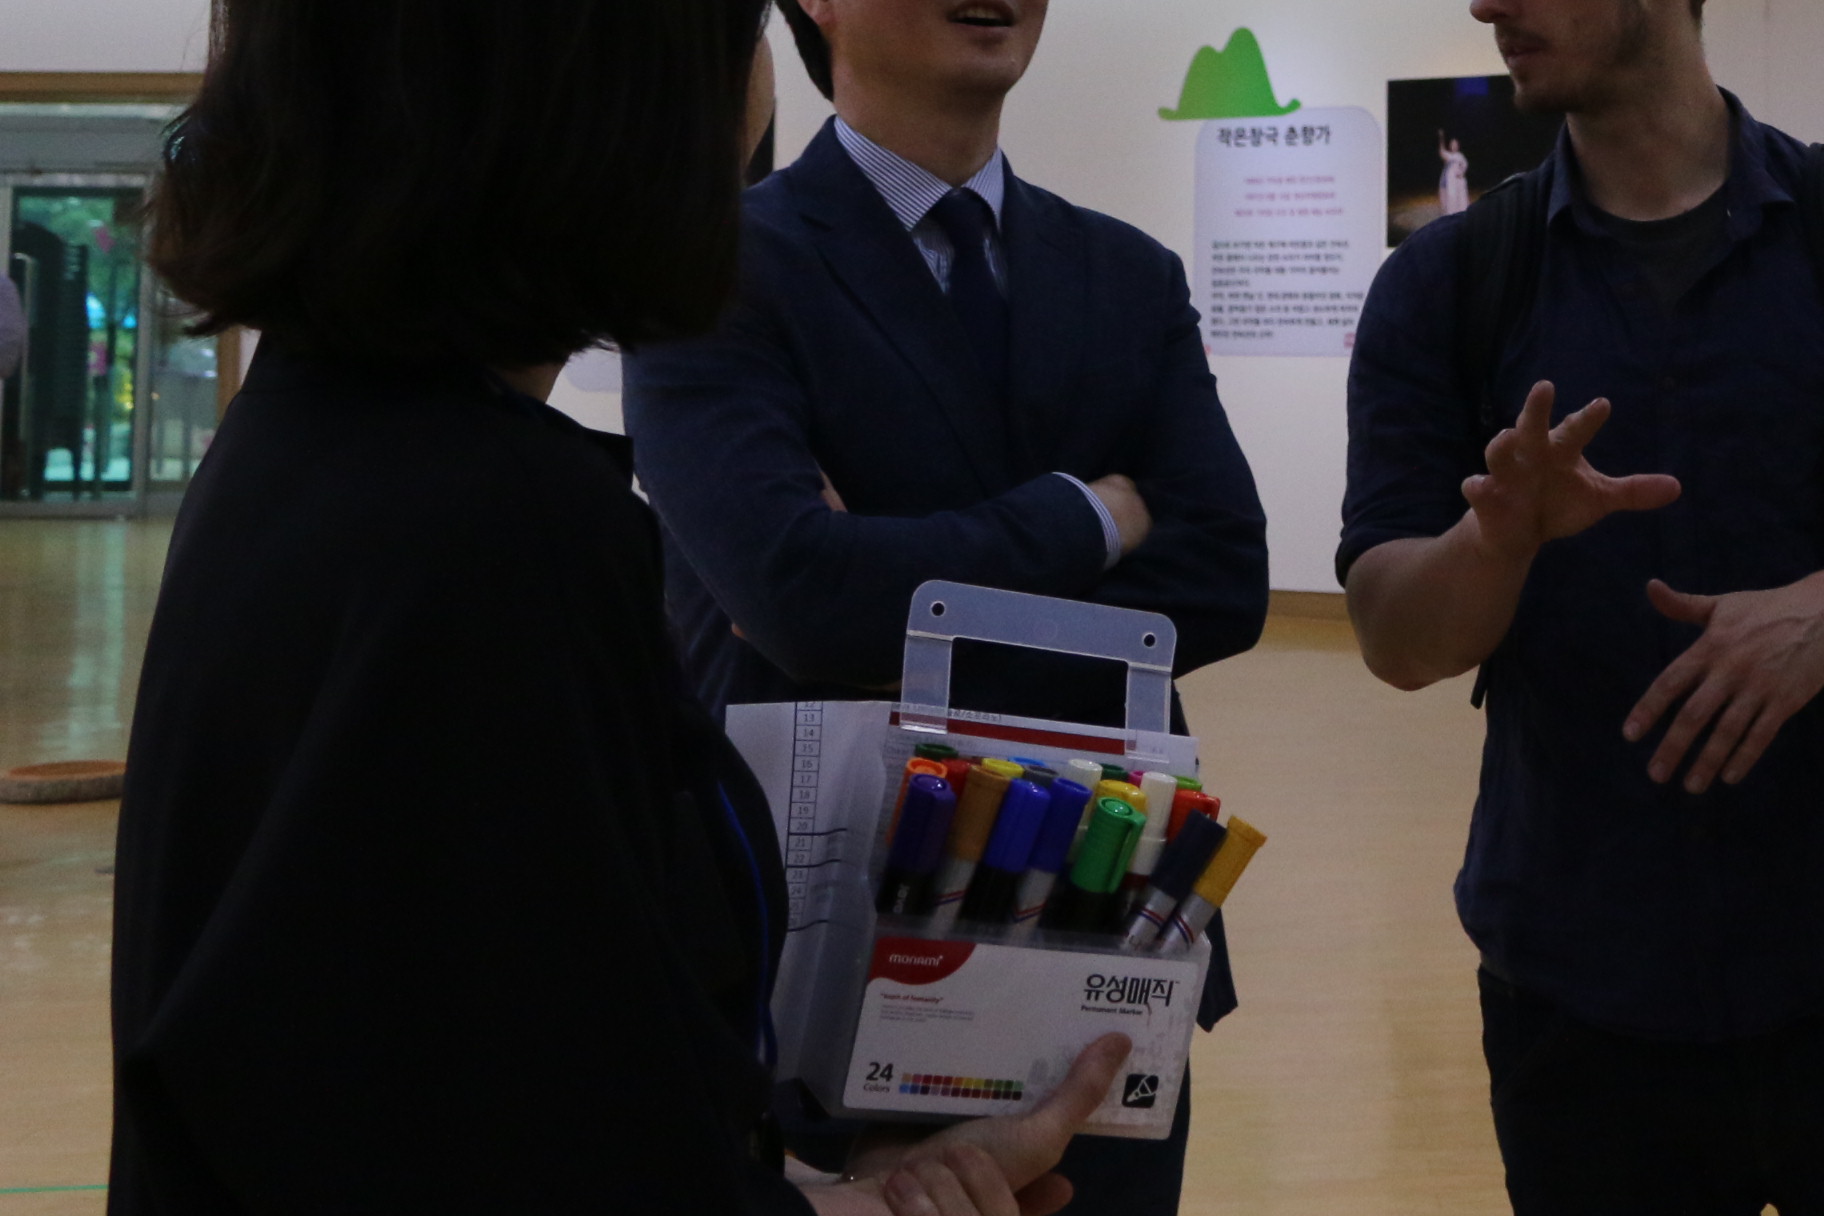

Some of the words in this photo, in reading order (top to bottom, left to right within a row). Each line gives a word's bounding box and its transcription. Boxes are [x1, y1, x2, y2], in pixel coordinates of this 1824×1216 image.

[803, 713, 815, 723] 13
[803, 728, 814, 738] 14
[802, 744, 814, 753] 15
[801, 759, 813, 769] 16
[800, 775, 812, 784] 17
[799, 790, 811, 800] 18
[797, 806, 809, 815] 19
[796, 822, 808, 831] 20
[795, 838, 806, 847] 21
[793, 854, 805, 863] 22
[792, 870, 803, 879] 23
[889, 953, 943, 968] monami
[1083, 973, 1175, 1007] 유성매직
[1080, 1005, 1117, 1014] Permanent
[1118, 1007, 1144, 1016] Marker
[865, 1061, 894, 1082] 24
[863, 1083, 890, 1093] Colors
